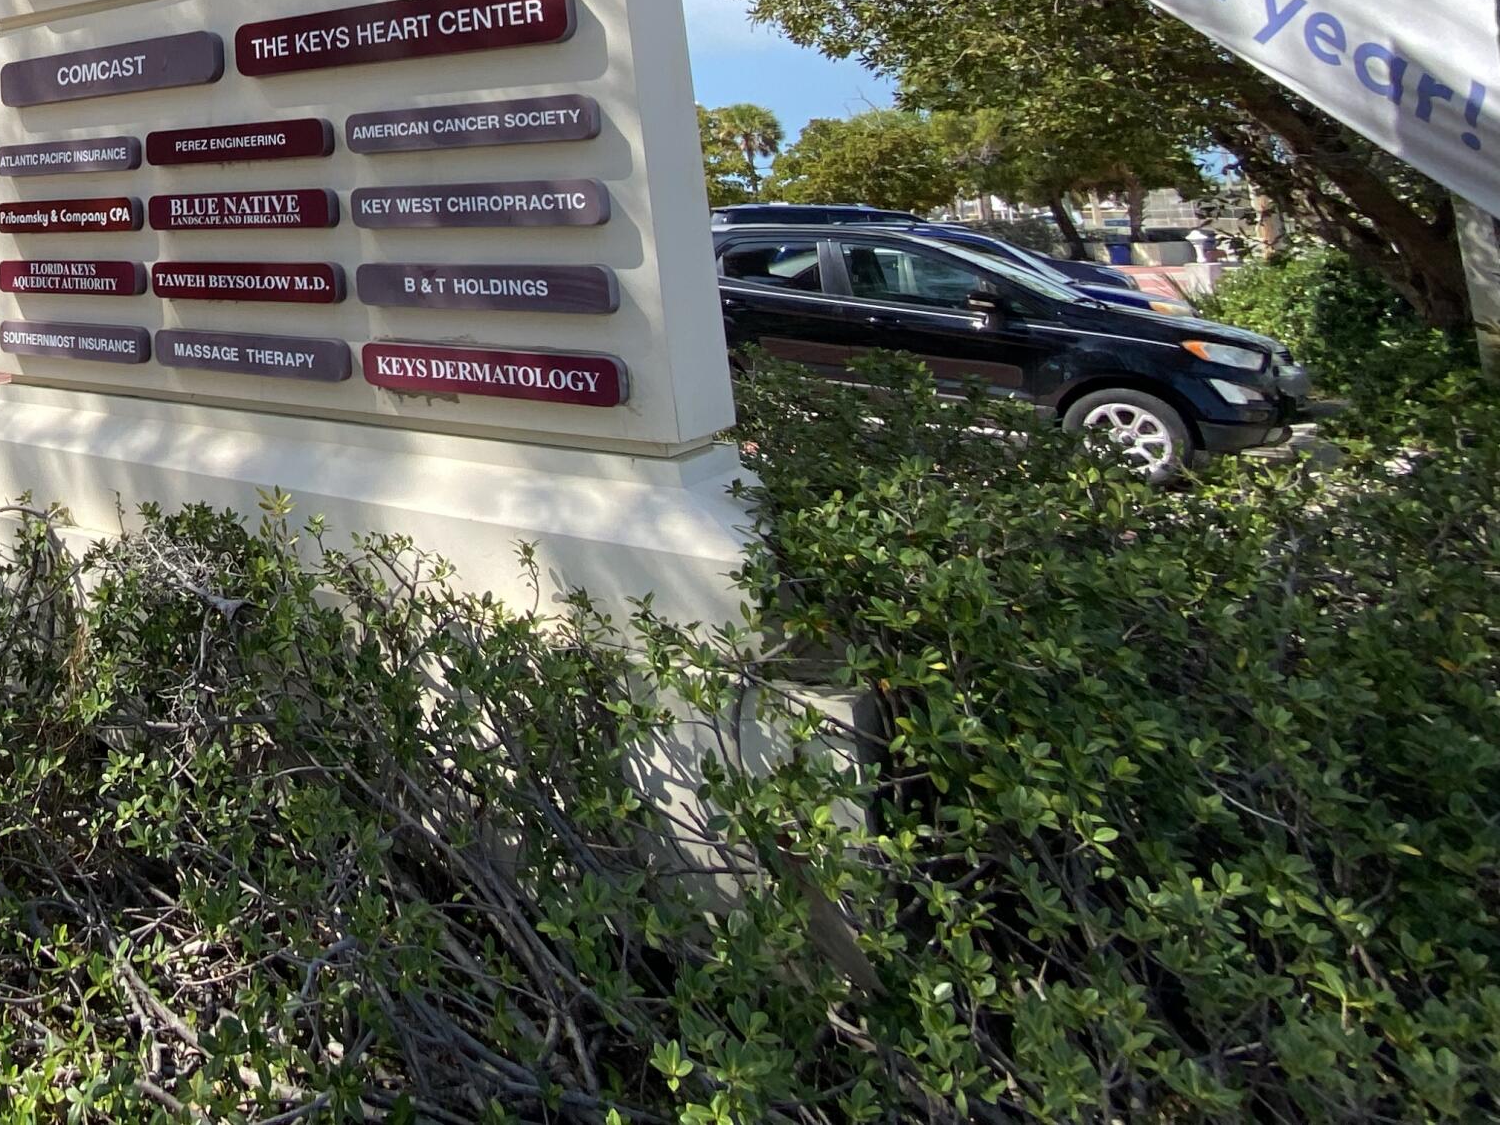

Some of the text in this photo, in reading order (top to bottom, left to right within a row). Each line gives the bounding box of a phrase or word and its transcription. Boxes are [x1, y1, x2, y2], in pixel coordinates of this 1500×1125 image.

[252, 36, 288, 59] THE
[294, 26, 350, 54] KEYS
[357, 14, 431, 46] HEART
[57, 55, 146, 86] COMCAST
[352, 109, 580, 140] AMERICAN CANCER SOCIETY
[176, 133, 285, 152] PEREZ ENGINEERING
[0, 147, 126, 167] ATLANTIC PACIFIC INSURANCE
[171, 195, 299, 216] BLUE NATIVE
[361, 193, 586, 213] KEY WEST CHIROPRACTIC
[0, 207, 130, 226] Pribramsky & Company CPA
[171, 213, 300, 225] LANDSCAPE AND IRRIGATION
[30, 263, 96, 276] FLORIDA KEYS
[12, 277, 117, 291] AQUEDUCT AUTHORITY
[156, 274, 330, 291] TAWEH BEYSOLOW M.D.
[404, 278, 548, 296] B & T HOLDINGS
[3, 332, 136, 353] SOUTHERNMOST INSURANCE
[174, 343, 315, 368] MASSAGE THERAPY
[376, 356, 600, 393] KEYS DERMATOLOGY
